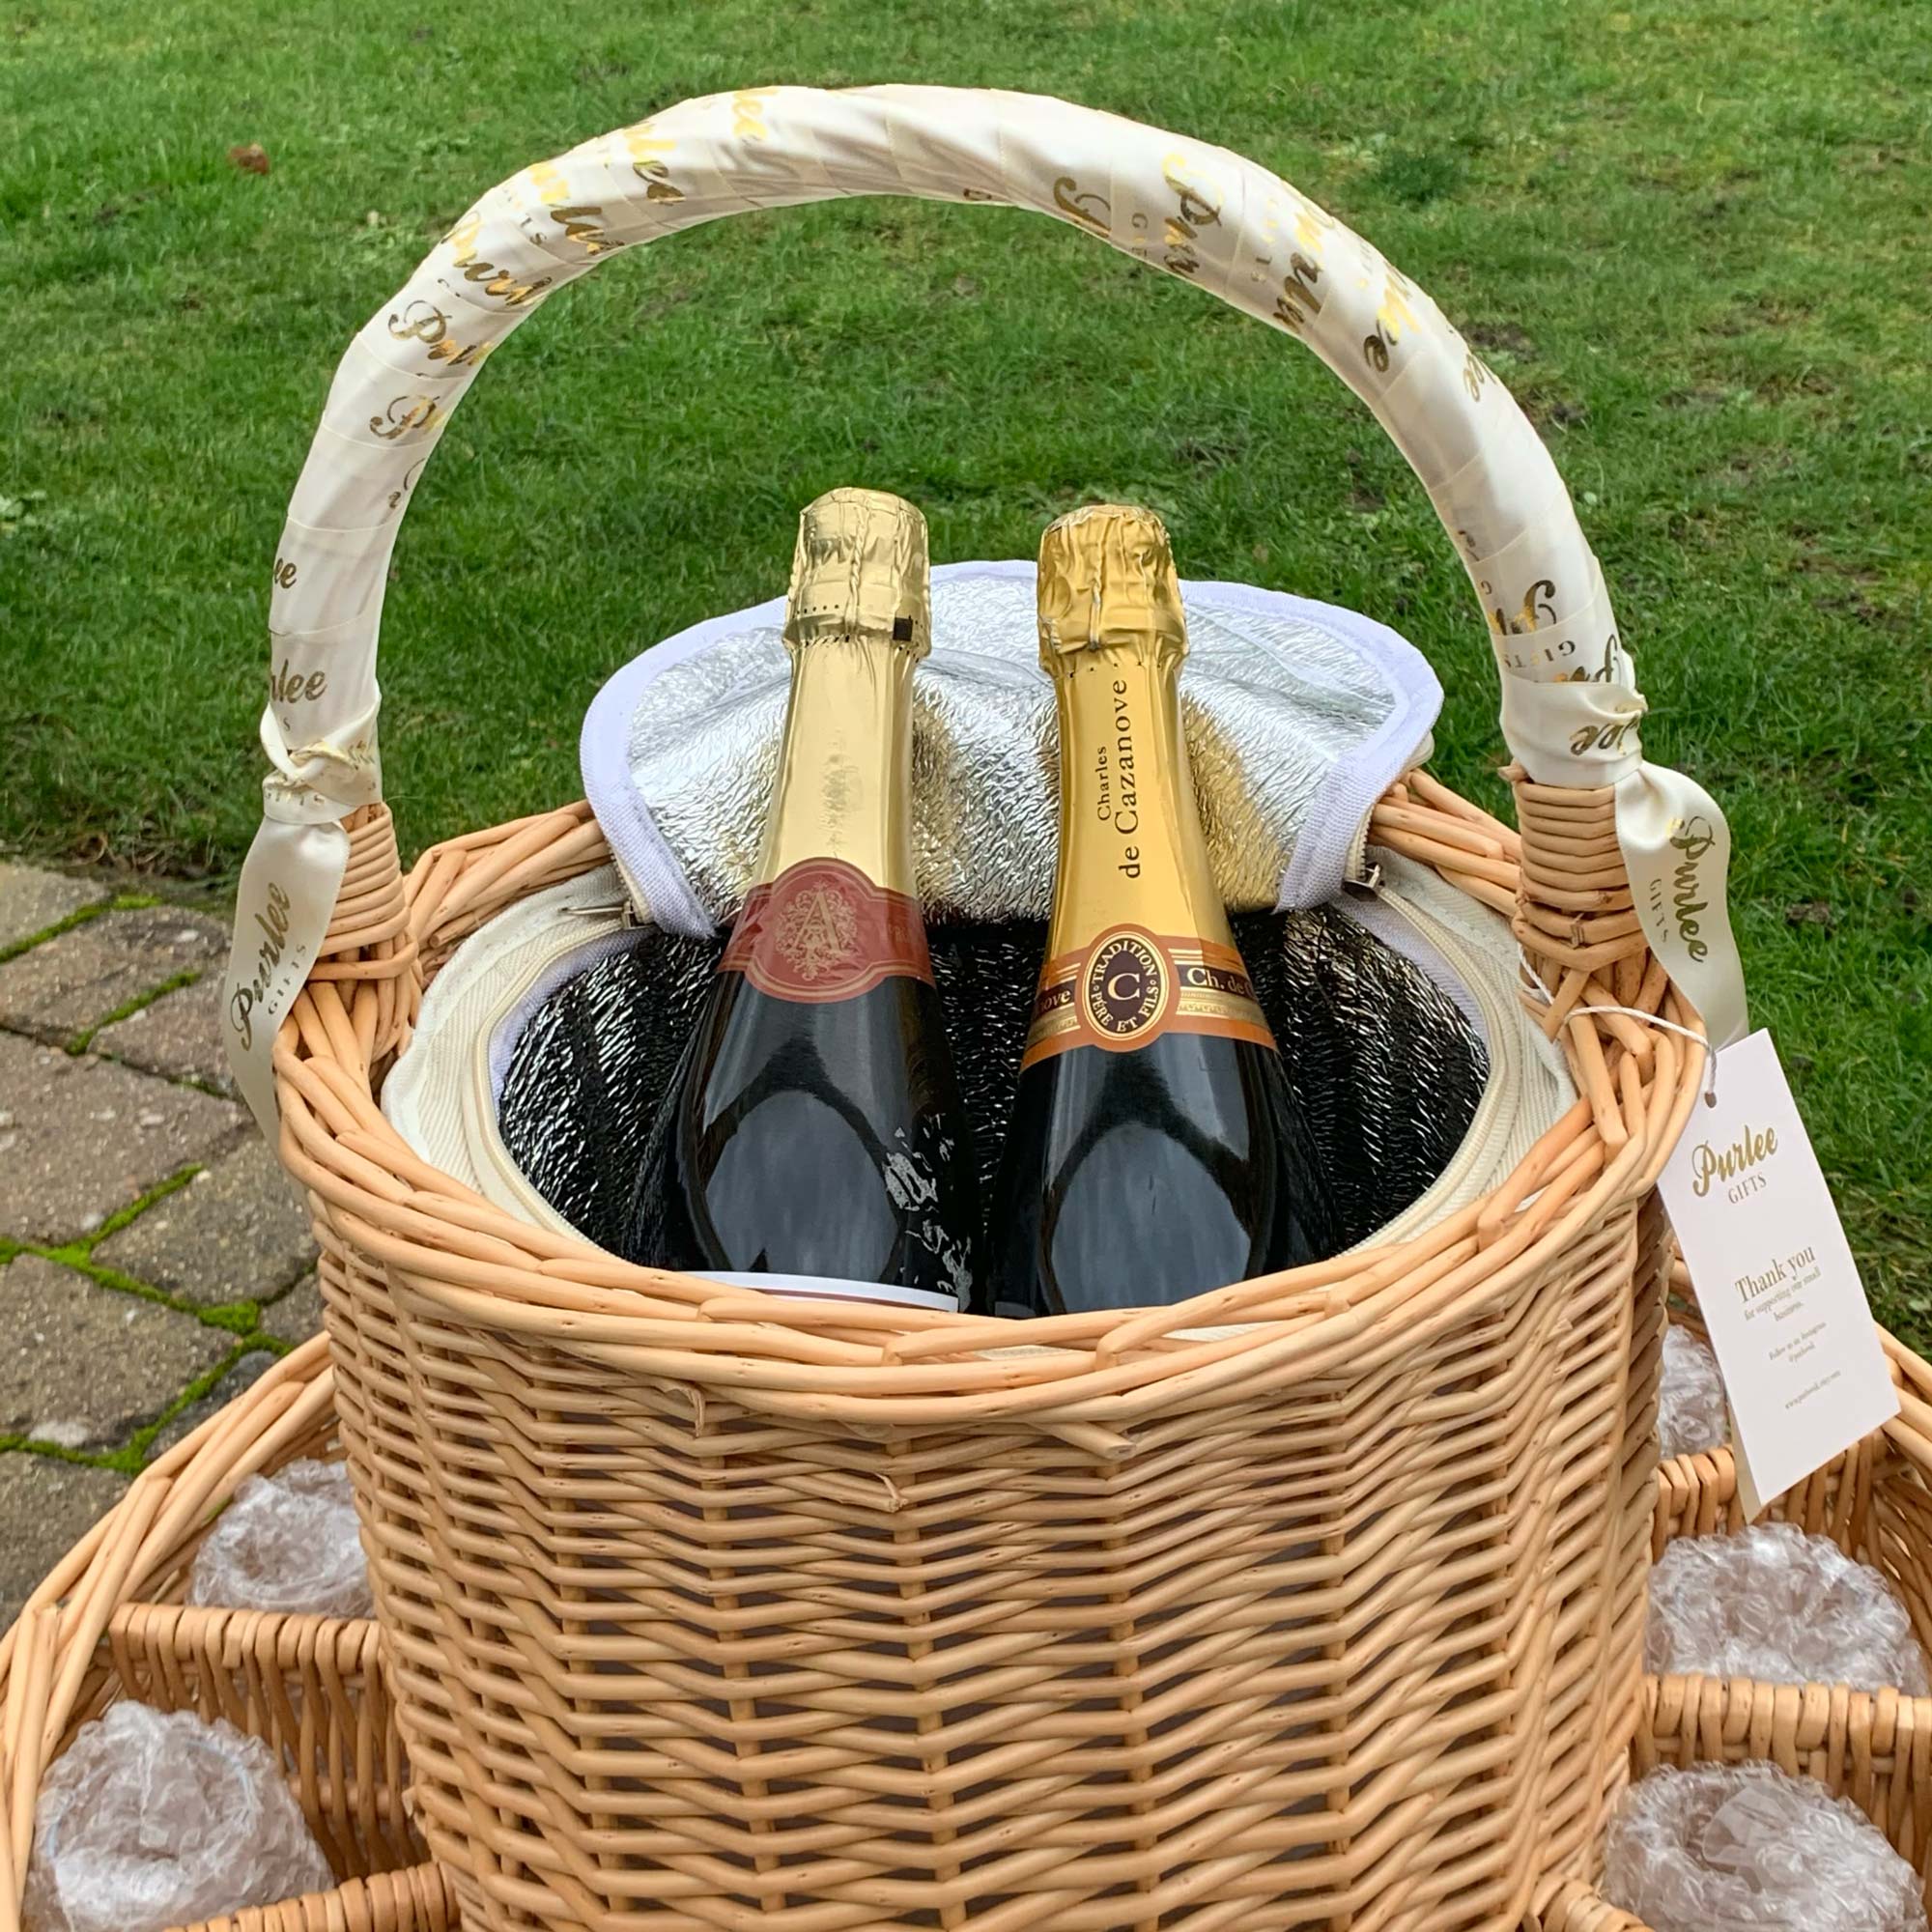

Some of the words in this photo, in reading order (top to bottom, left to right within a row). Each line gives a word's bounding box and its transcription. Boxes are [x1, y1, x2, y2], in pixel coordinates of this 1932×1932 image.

[1095, 746, 1112, 821] Charles
[1113, 679, 1140, 835] Cazanove
[1118, 845, 1142, 879] de
[1669, 815, 1716, 963] Purlee
[230, 882, 292, 1052] Purlee
[1092, 940, 1158, 984] TRADITION
[1107, 972, 1141, 1001] C
[1187, 967, 1225, 990] Ch.
[1117, 1016, 1138, 1033] ET
[1138, 985, 1159, 1018] FILS
[1691, 1124, 1778, 1198] Purlee
[1727, 1173, 1767, 1205] GIFTS
[1734, 1258, 1787, 1304] Thank
[1787, 1246, 1816, 1281] you
